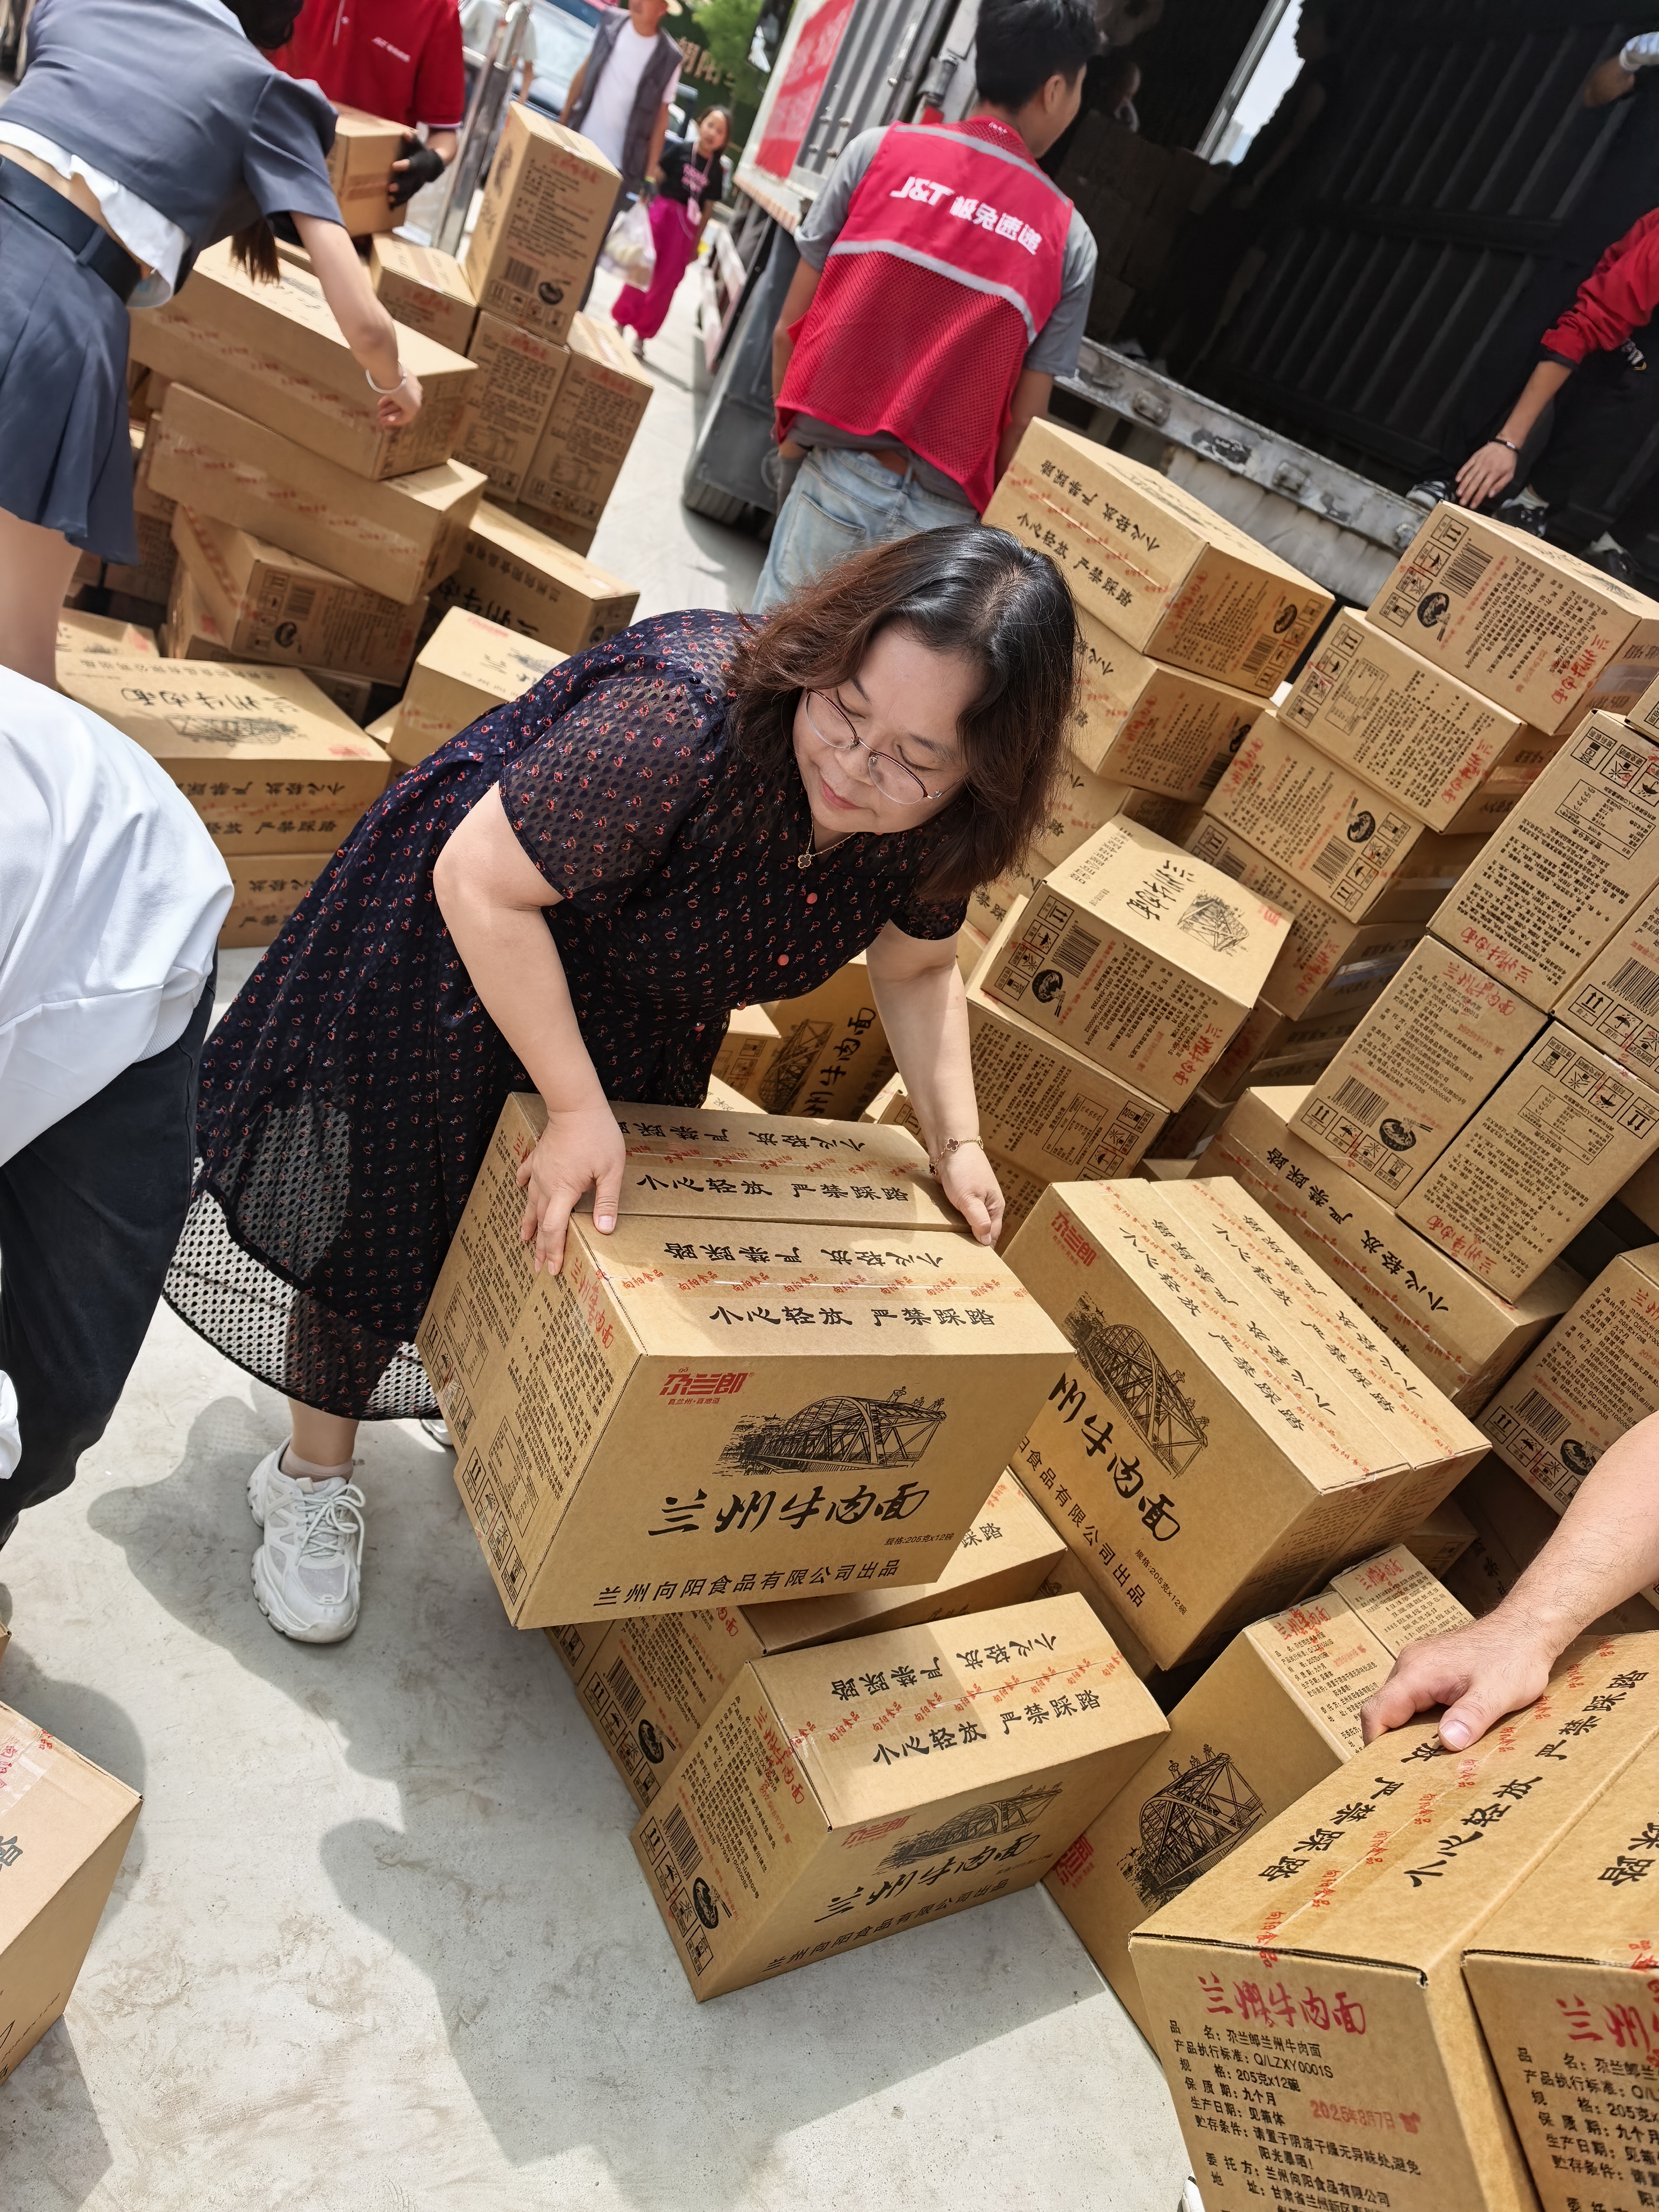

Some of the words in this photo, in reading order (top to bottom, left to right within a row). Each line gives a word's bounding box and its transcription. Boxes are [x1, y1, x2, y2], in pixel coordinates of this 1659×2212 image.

[889, 176, 955, 206] J&T
[949, 195, 1043, 255] 极兔速递
[1100, 503, 1159, 555] 小心轻放
[1014, 510, 1071, 562] 小心轻放
[1071, 554, 1135, 610] 严禁踩踏
[180, 781, 253, 797] 严禁踩
[266, 781, 345, 795] 小心轻放
[1461, 927, 1532, 983] 兰州牛肉面
[754, 1134, 865, 1151] 小心轻放
[637, 1175, 772, 1195] 小心轻放
[791, 1184, 908, 1201] 严禁踩踏
[1264, 1145, 1356, 1228] 严禁踩踏
[664, 1243, 801, 1263] 严禁踩踏
[821, 1249, 943, 1267] 小心轻放
[1358, 1228, 1451, 1311] 小心轻放
[571, 1258, 613, 1348] 兰州牛肉面
[622, 1269, 664, 1288] 向阳食品
[678, 1271, 717, 1291] 向阳食品
[733, 1272, 769, 1291] 向阳食品
[784, 1274, 818, 1292] 向阳食品
[833, 1275, 866, 1293] 向阳食品
[880, 1277, 912, 1294] 向阳食品
[926, 1278, 956, 1296] 向阳食品
[970, 1279, 1000, 1297] 向阳食品
[710, 1306, 852, 1325] 小心轻放
[871, 1308, 995, 1326] 严禁踩踏
[1118, 1225, 1204, 1319] 小心轻放
[1206, 1330, 1305, 1434] 严禁踩踏
[1211, 1221, 1296, 1309] 小心轻放
[1299, 1318, 1398, 1415] 严禁踩踏
[659, 1372, 746, 1396] 尕兰郎
[1250, 1321, 1335, 1415] 小心轻放
[648, 1481, 931, 1539] 兰州牛肉面
[884, 1533, 954, 1545] 规格:205克x12碗
[594, 1560, 903, 1610] 兰州向阳食品有限公司出品
[1132, 1549, 1186, 1619] 规格:205克x12碗
[956, 1633, 1056, 1673] 小心轻放
[829, 1711, 859, 1742] 向阳食品
[873, 1702, 902, 1731] 向阳食品
[914, 1692, 942, 1722] 向阳食品
[954, 1683, 981, 1711] 向阳食品
[994, 1676, 1019, 1702] 向阳食品
[1031, 1667, 1057, 1694] 向阳食品
[1067, 1658, 1090, 1684] 向阳食品
[1102, 1651, 1123, 1676] 向阳食品
[831, 1657, 942, 1705] 严禁踩踏
[1533, 1695, 1551, 1719] 向阳食品
[872, 1718, 986, 1765] 小心轻放
[999, 1688, 1100, 1735] 严禁踩踏
[1499, 1727, 1515, 1752] 向阳食品
[755, 1707, 804, 1804] 兰州牛肉面
[1402, 1775, 1543, 1887] 小心轻放
[1533, 1668, 1649, 1760] 严禁踩踏
[1459, 1759, 1476, 1788] 向阳食品
[1256, 1775, 1404, 1881] 严禁踩踏
[1414, 1794, 1436, 1825] 向阳食品
[1366, 1831, 1387, 1865] 向阳食品
[814, 1830, 1040, 1923] 兰州牛肉面
[1312, 1870, 1339, 1907] 向阳食品
[763, 1878, 1010, 1972] 兰州向阳食品有限公司出品
[1256, 1912, 1285, 1968] 向阳食品
[1198, 1974, 1365, 2034] 兰州牛肉面
[1557, 1997, 1659, 2053] 兰州
[1518, 2047, 1659, 2081] 品名：尕兰郎兰
[1523, 2069, 1659, 2102] 产品执行标准：Q/L
